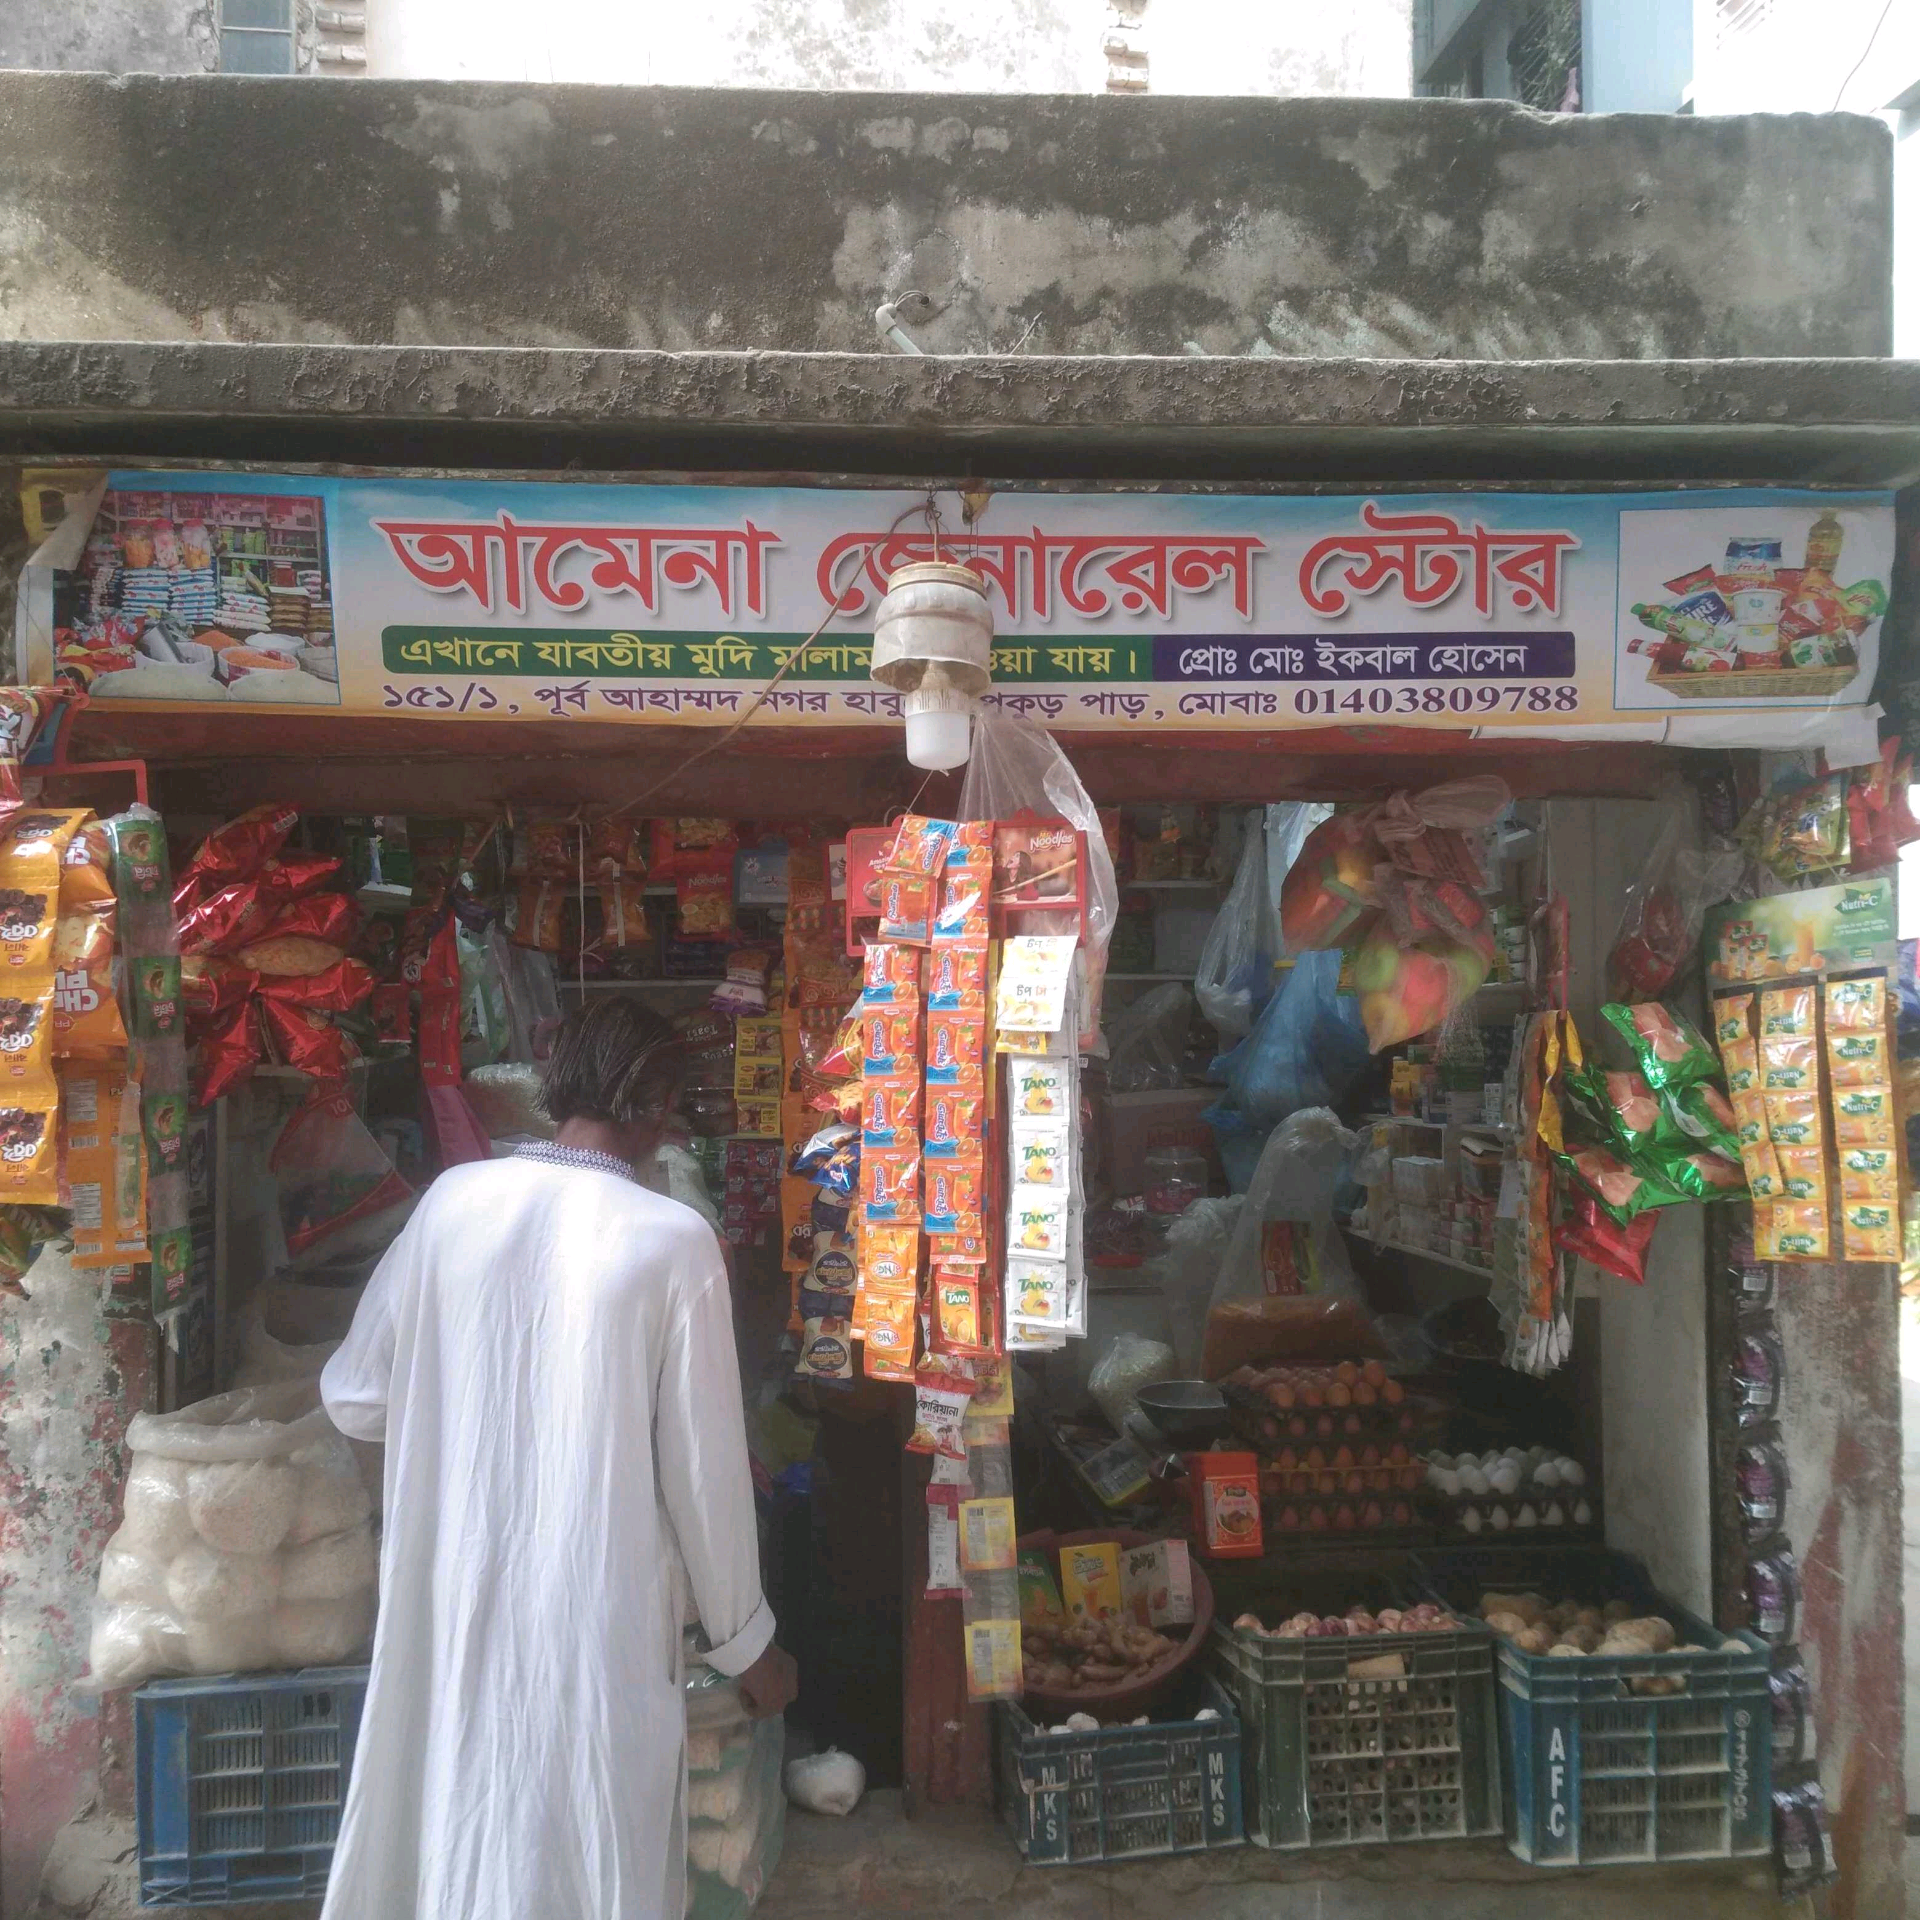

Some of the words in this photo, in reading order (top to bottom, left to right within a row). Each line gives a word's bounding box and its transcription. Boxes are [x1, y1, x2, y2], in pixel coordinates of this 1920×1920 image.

[376, 513, 783, 616] আমেনা
[816, 524, 1265, 619] জেনারেল
[1299, 504, 1572, 613] স্টোর
[400, 637, 524, 668] এখানে
[532, 632, 677, 670] যাবতীয়
[684, 635, 759, 677] মুদি
[1046, 645, 1116, 674] যায়
[1178, 644, 1238, 677] প্রোঃ
[1249, 644, 1305, 675] মোঃ
[1313, 637, 1420, 676] ইকবাল
[1428, 642, 1529, 674] হোসেন
[533, 680, 592, 718] পূর্ব
[598, 687, 744, 713] আহাম্মদ
[752, 689, 833, 714] নগর
[1178, 690, 1278, 716] মোবাঃ
[1294, 685, 1579, 716] 01403809788
[1029, 830, 1074, 851] Noodles
[1841, 895, 1879, 911] Nutri-C
[1841, 1043, 1874, 1056] Nutri-C
[1846, 1101, 1878, 1113] Nutri-C
[916, 1399, 959, 1418] কোরিয়ানা
[1207, 1752, 1225, 1827] MKS
[1547, 1727, 1567, 1838] AFC
[1041, 1766, 1058, 1841] MKS
